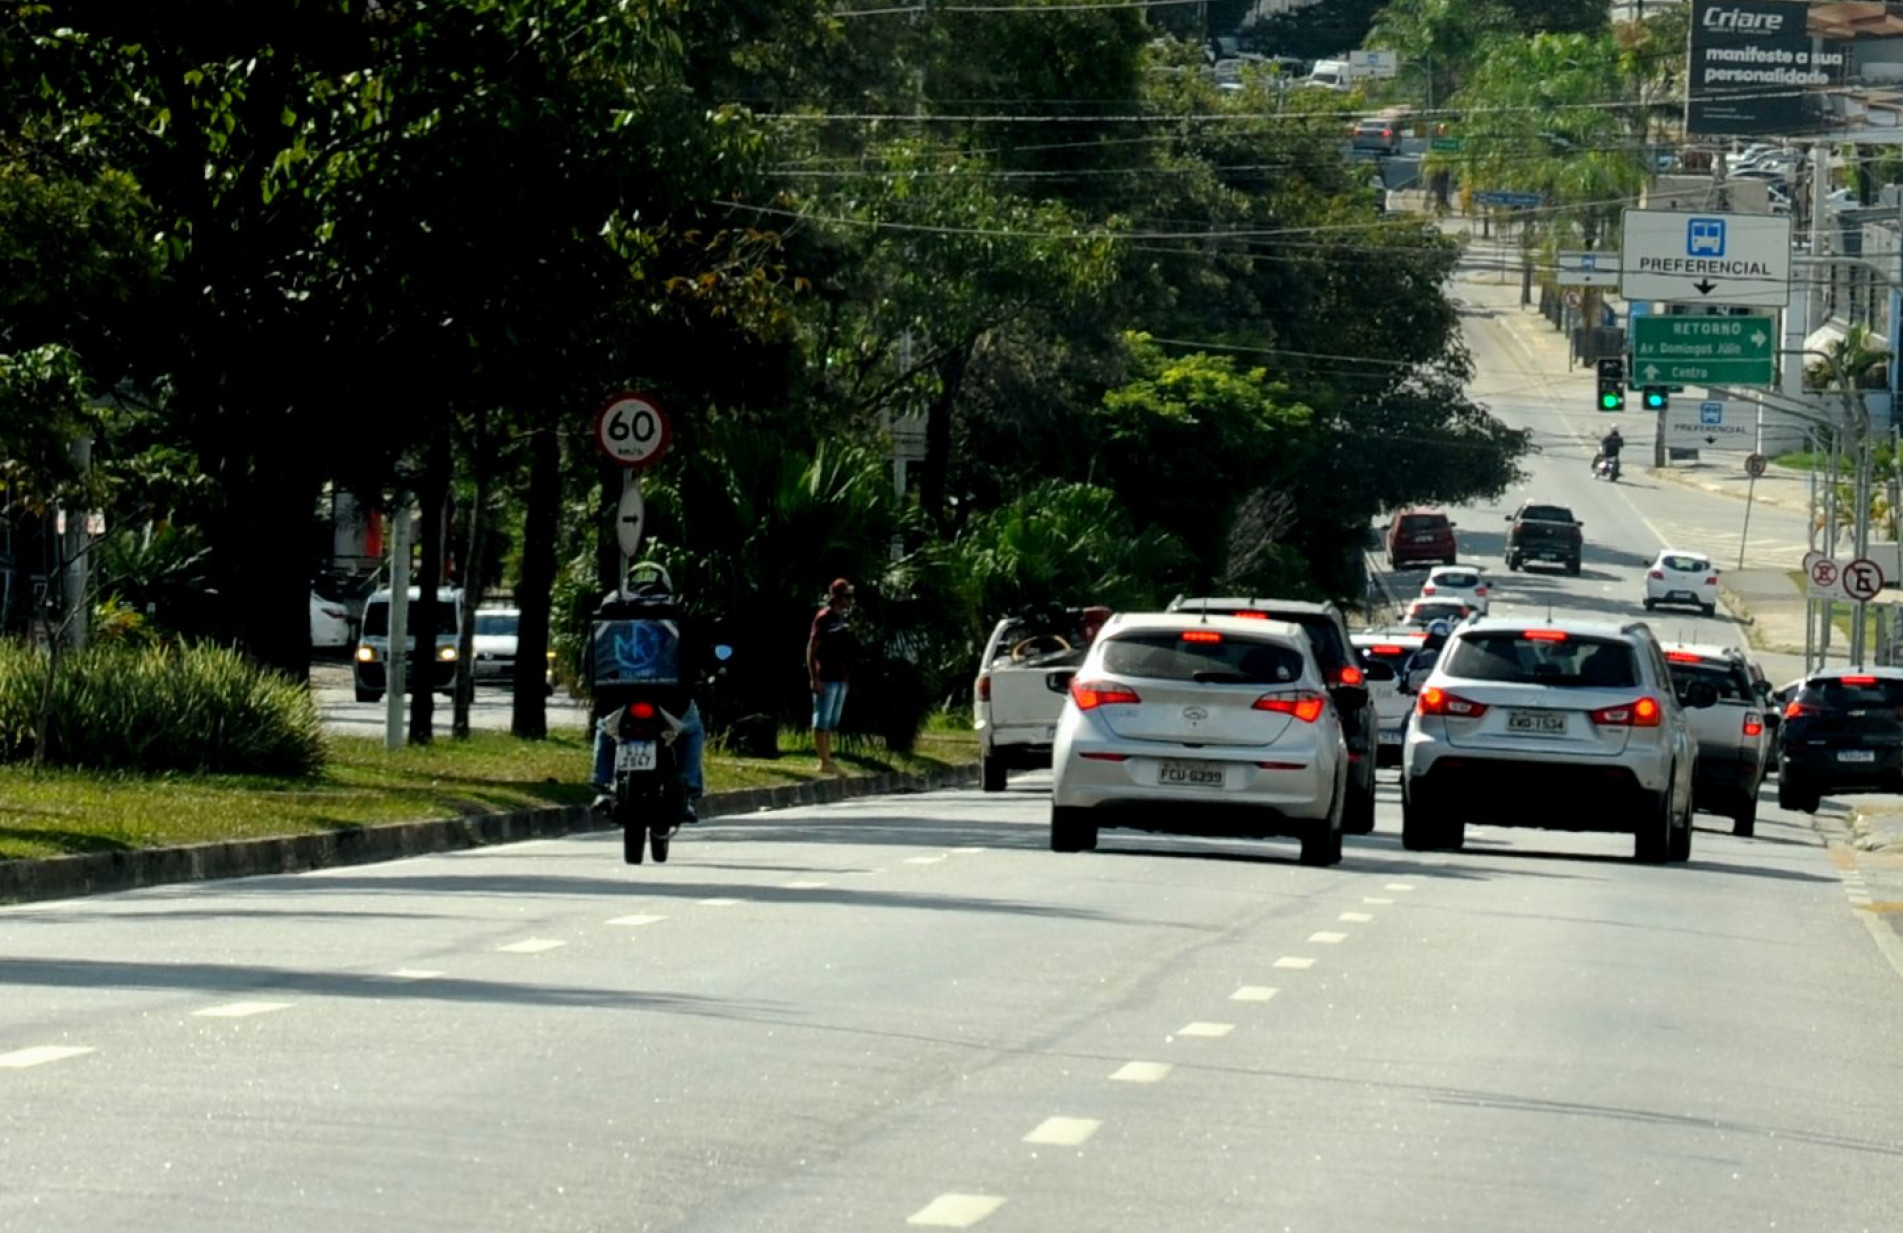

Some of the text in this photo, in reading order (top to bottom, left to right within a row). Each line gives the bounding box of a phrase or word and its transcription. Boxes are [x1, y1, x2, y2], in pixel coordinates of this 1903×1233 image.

[1703, 7, 1784, 30] Criare
[1706, 46, 1843, 65] manifeste a sua
[1704, 67, 1829, 85] personalidade
[1640, 257, 1771, 275] PREFERENCIAL
[1673, 323, 1741, 335] RETORNO
[1639, 343, 1657, 354] Av.
[1660, 342, 1713, 356] Domingos
[1672, 366, 1708, 379] Centro
[608, 410, 655, 442] 60
[1674, 423, 1747, 434] PREFERENCIAL
